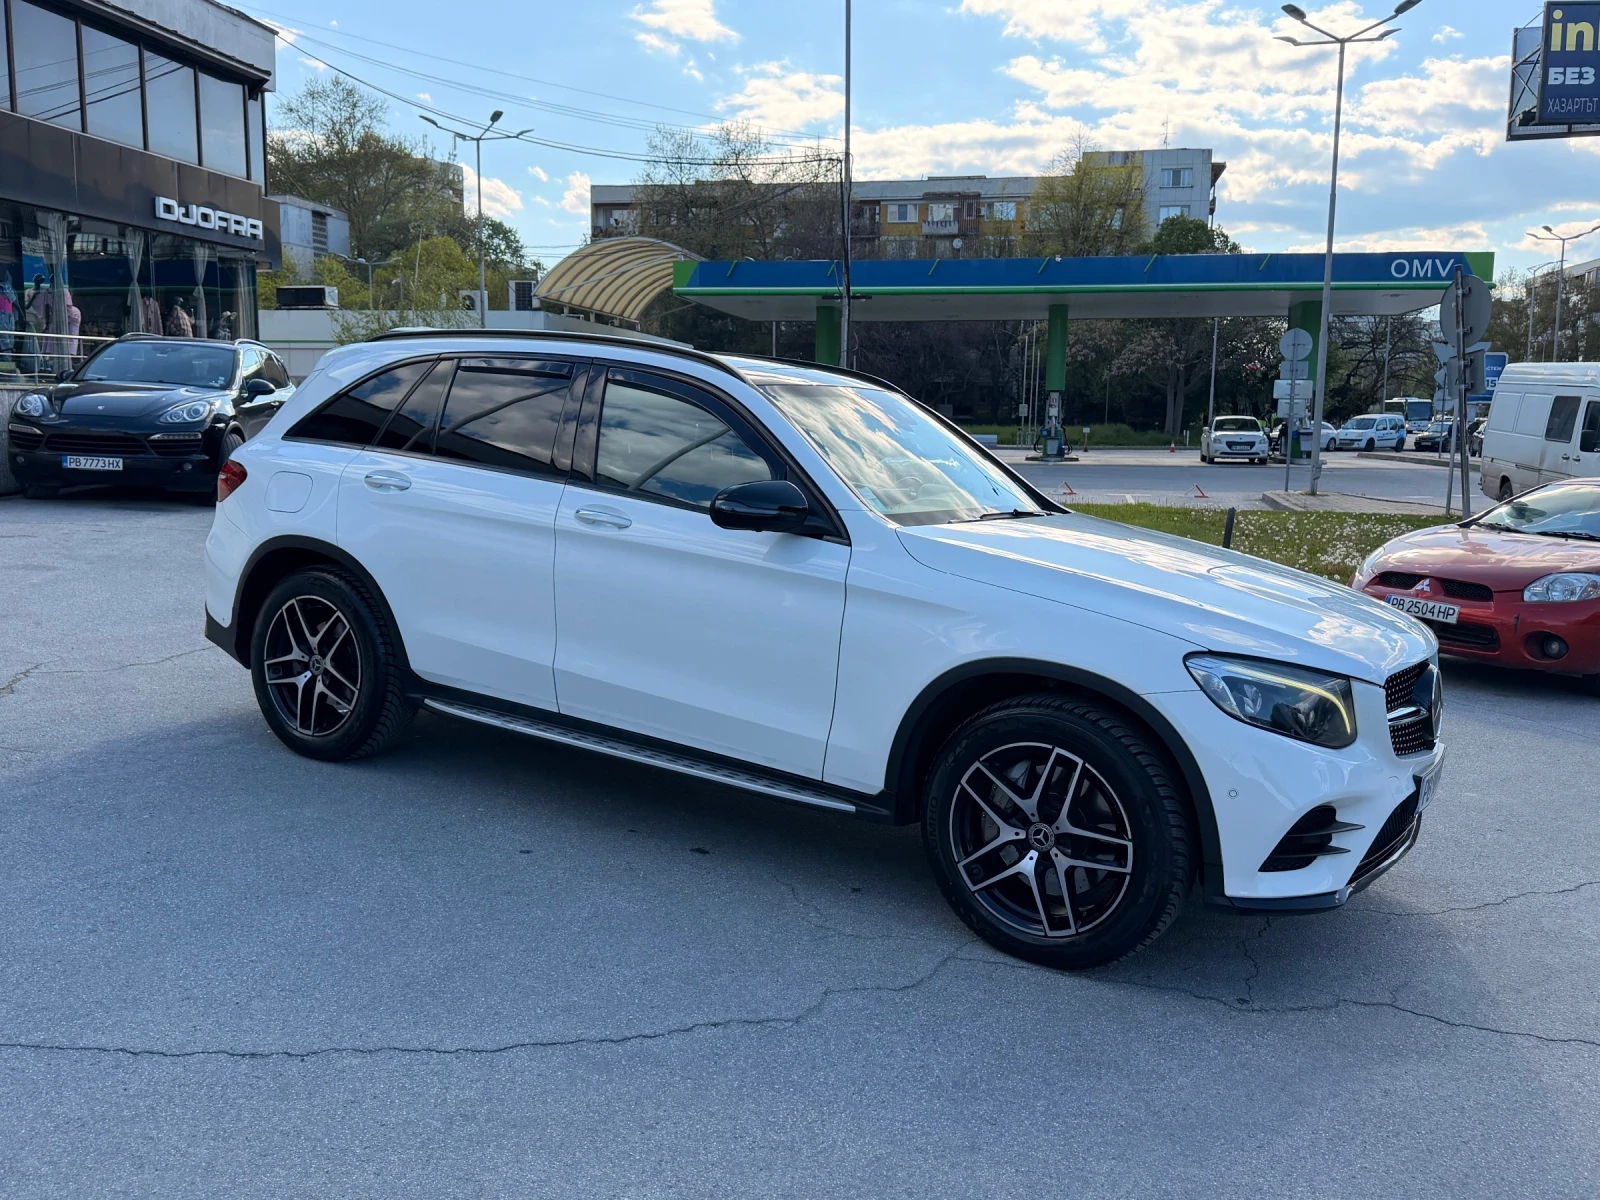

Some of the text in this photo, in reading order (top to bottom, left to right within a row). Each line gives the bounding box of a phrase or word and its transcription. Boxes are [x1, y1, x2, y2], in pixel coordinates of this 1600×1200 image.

[1550, 9, 1600, 51] in
[1547, 66, 1596, 85] БЕЗ
[1547, 98, 1598, 113] ХАЗАРТЪТ
[155, 196, 263, 240] DJOFRA
[1390, 259, 1455, 278] OMV
[83, 458, 107, 468] 7773
[1406, 600, 1436, 617] 2504
